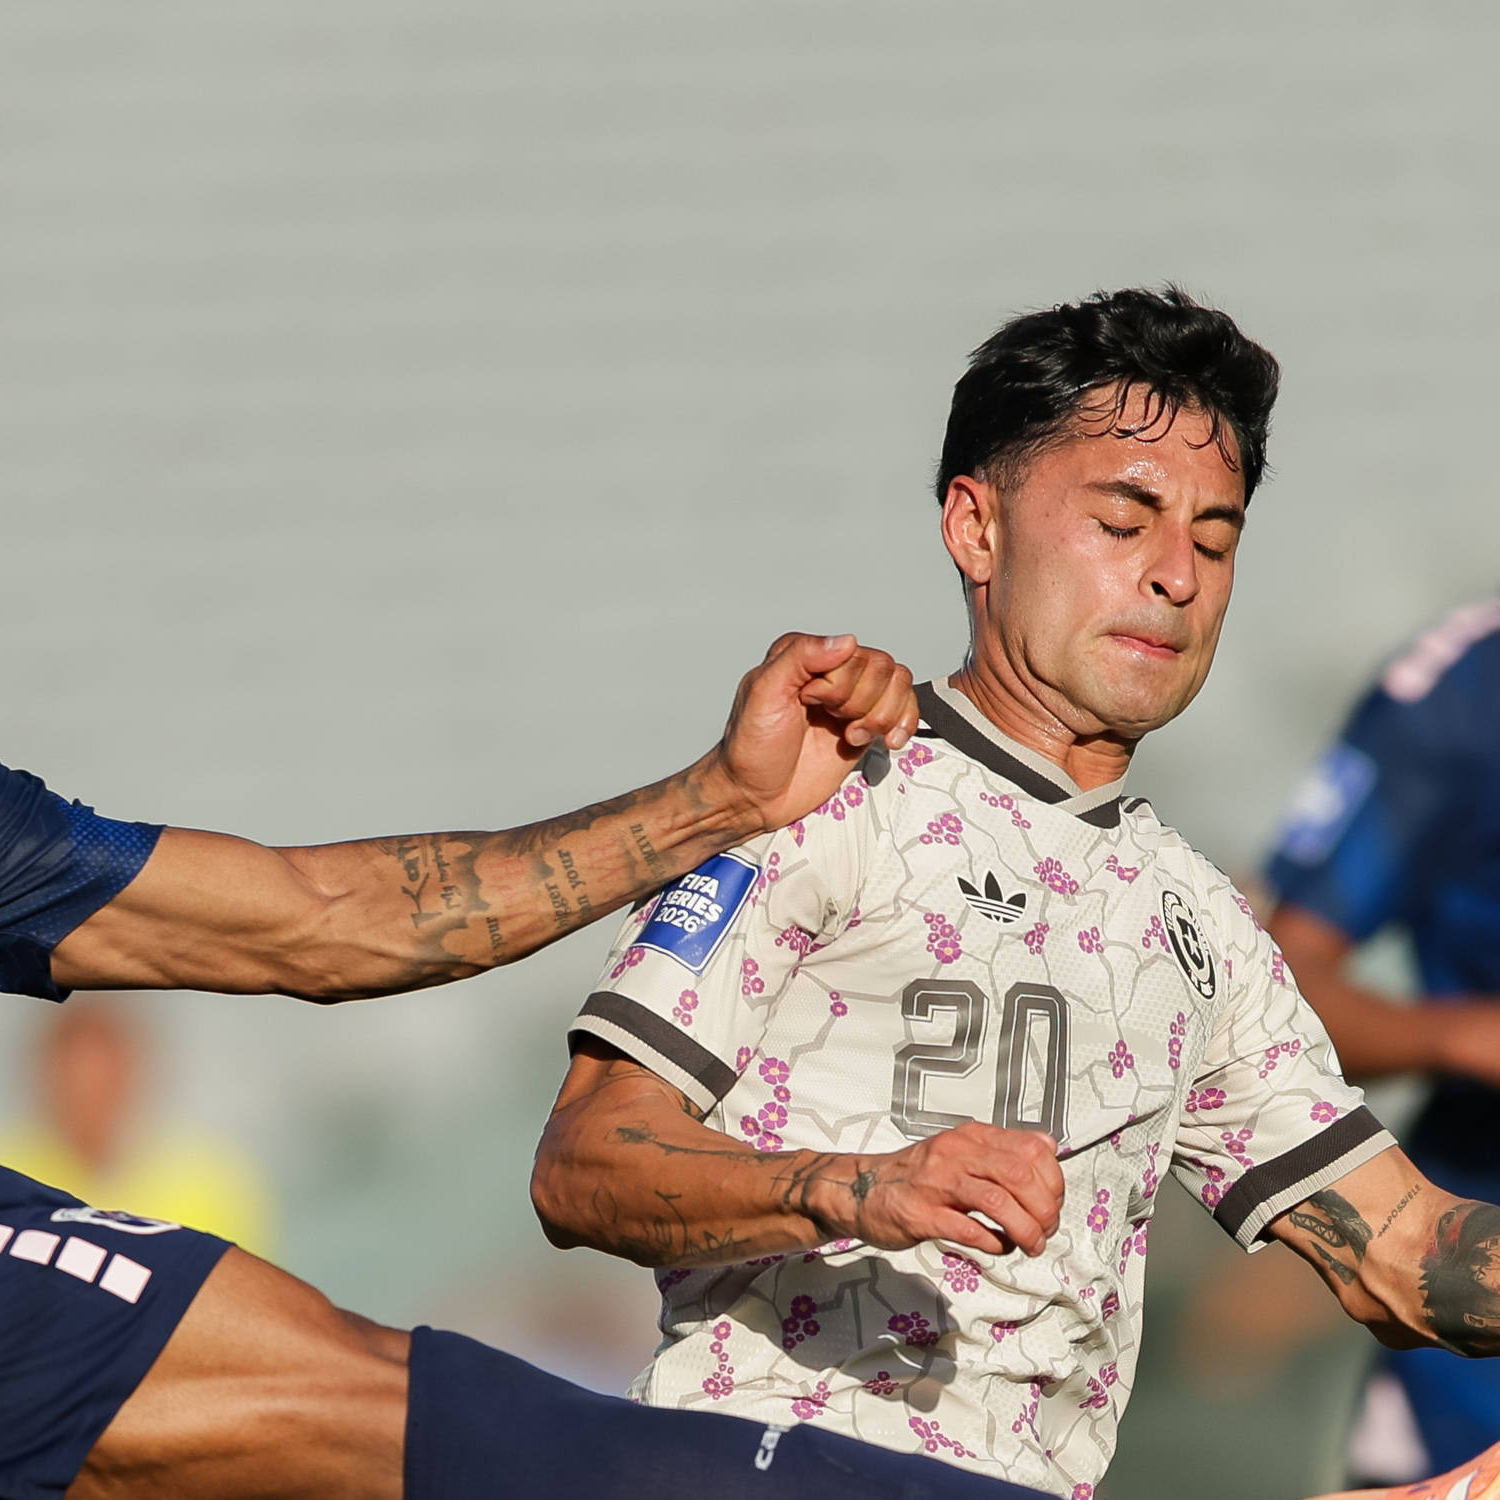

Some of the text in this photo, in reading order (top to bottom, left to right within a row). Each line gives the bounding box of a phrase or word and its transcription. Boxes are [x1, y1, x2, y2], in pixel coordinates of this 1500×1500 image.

[679, 873, 719, 899] FIFA
[655, 907, 701, 933] 2026
[662, 890, 725, 923] SERIES
[891, 978, 1071, 1146] 20
